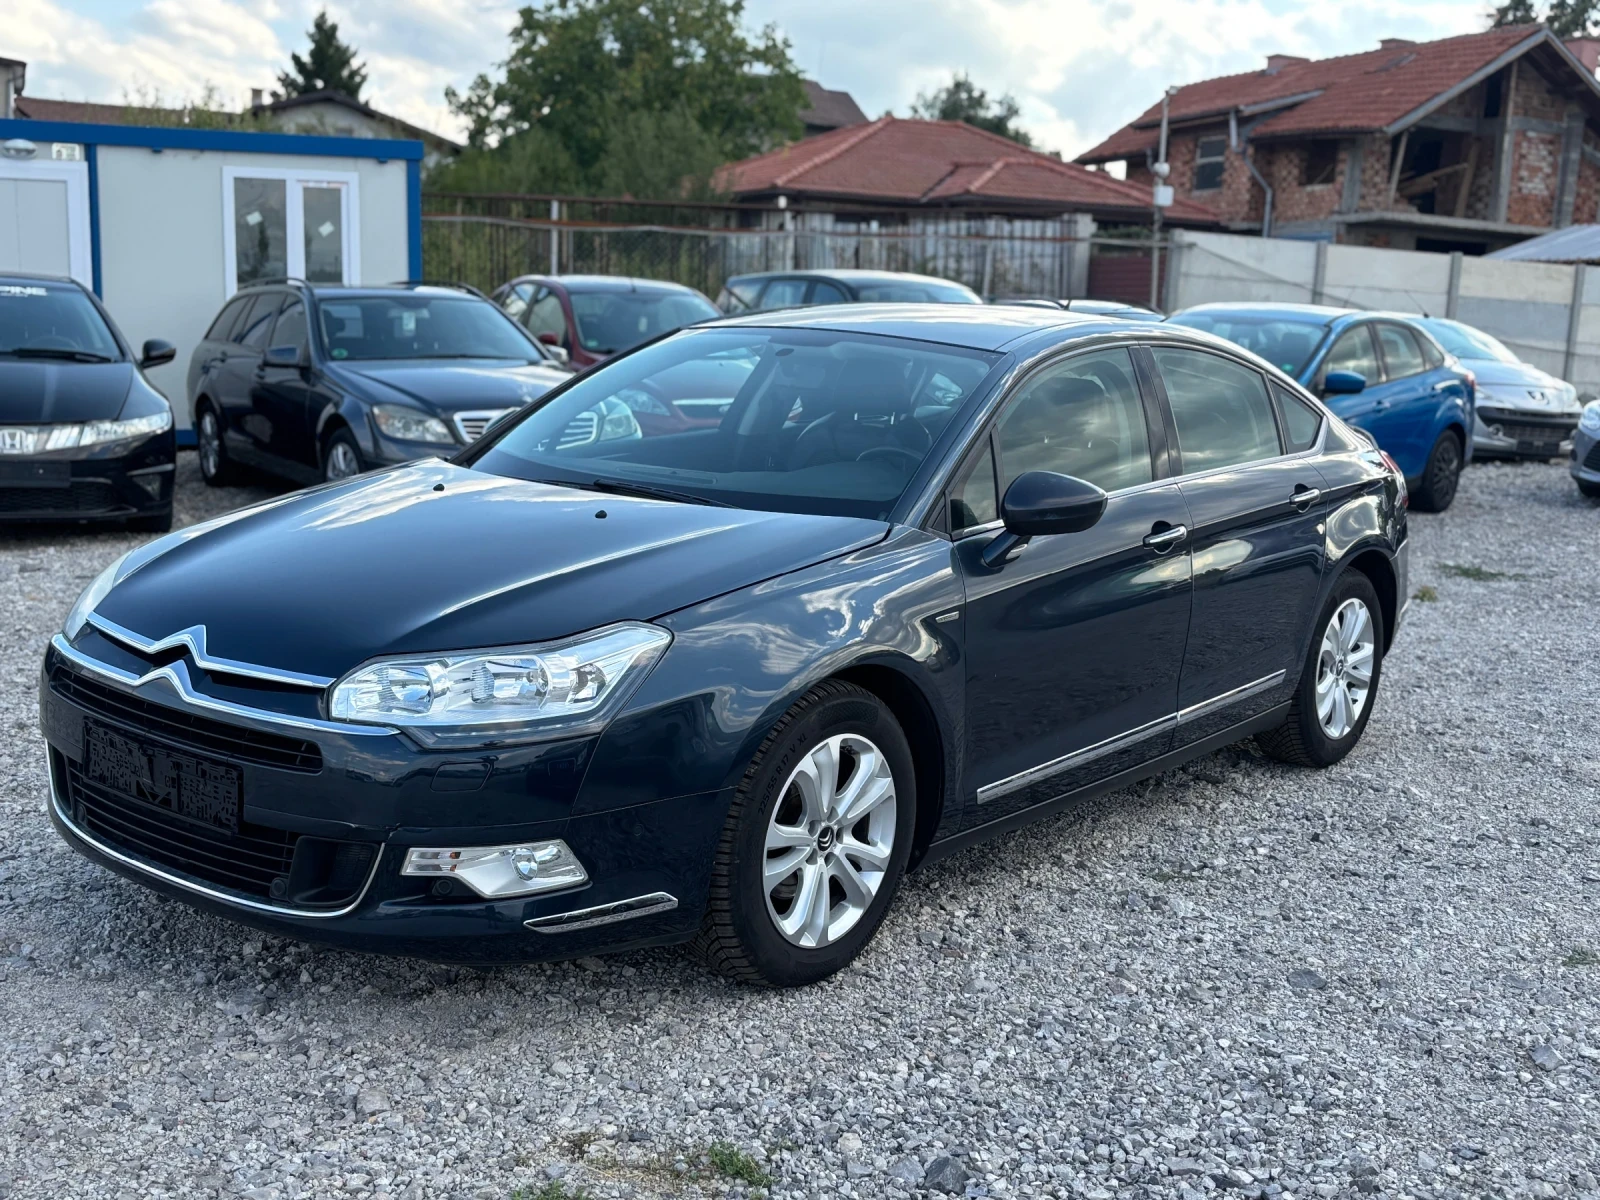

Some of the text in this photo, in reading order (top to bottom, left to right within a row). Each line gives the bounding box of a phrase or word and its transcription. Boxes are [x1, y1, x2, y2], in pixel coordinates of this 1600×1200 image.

[758, 776, 777, 815] 225/55
[775, 766, 784, 775] R
[781, 754, 789, 766] 17
[789, 743, 796, 753] V
